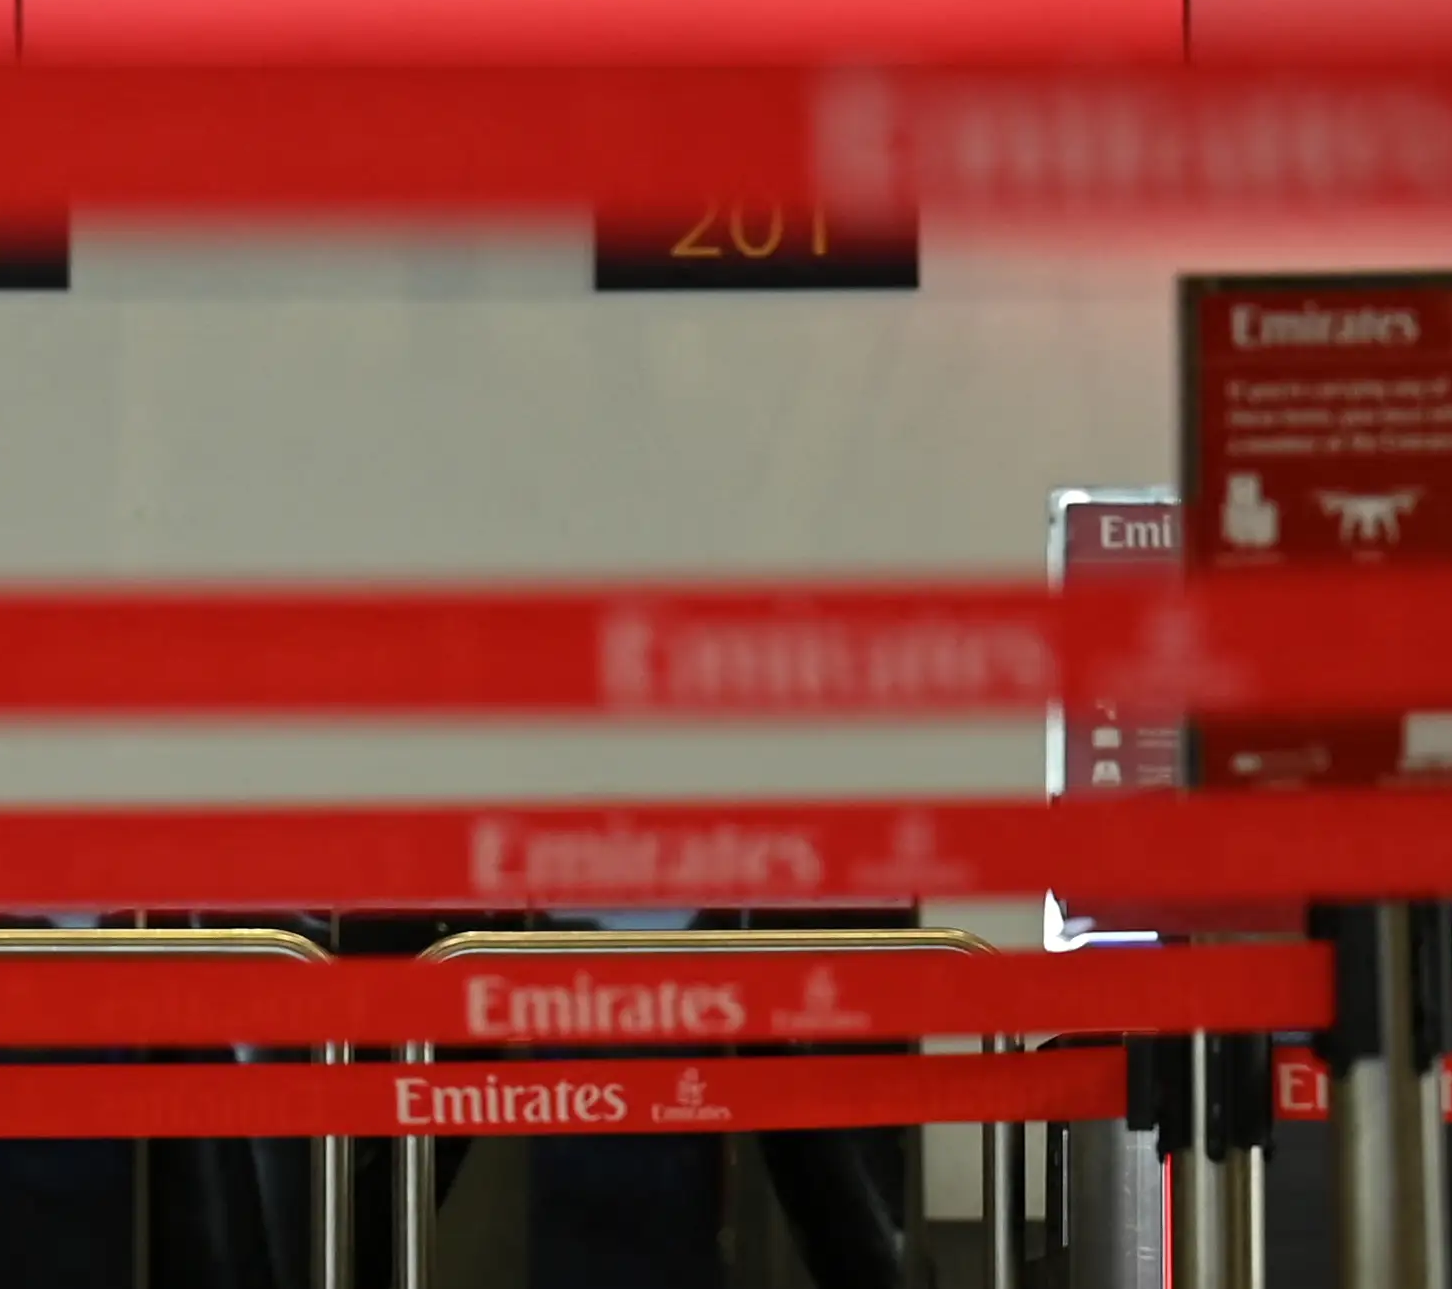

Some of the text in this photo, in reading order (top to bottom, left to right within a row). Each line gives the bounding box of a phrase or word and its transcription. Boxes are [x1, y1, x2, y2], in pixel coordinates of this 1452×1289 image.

[1229, 300, 1420, 350] Emirates
[467, 975, 746, 1036] Emirates
[394, 1074, 627, 1125] Emirates
